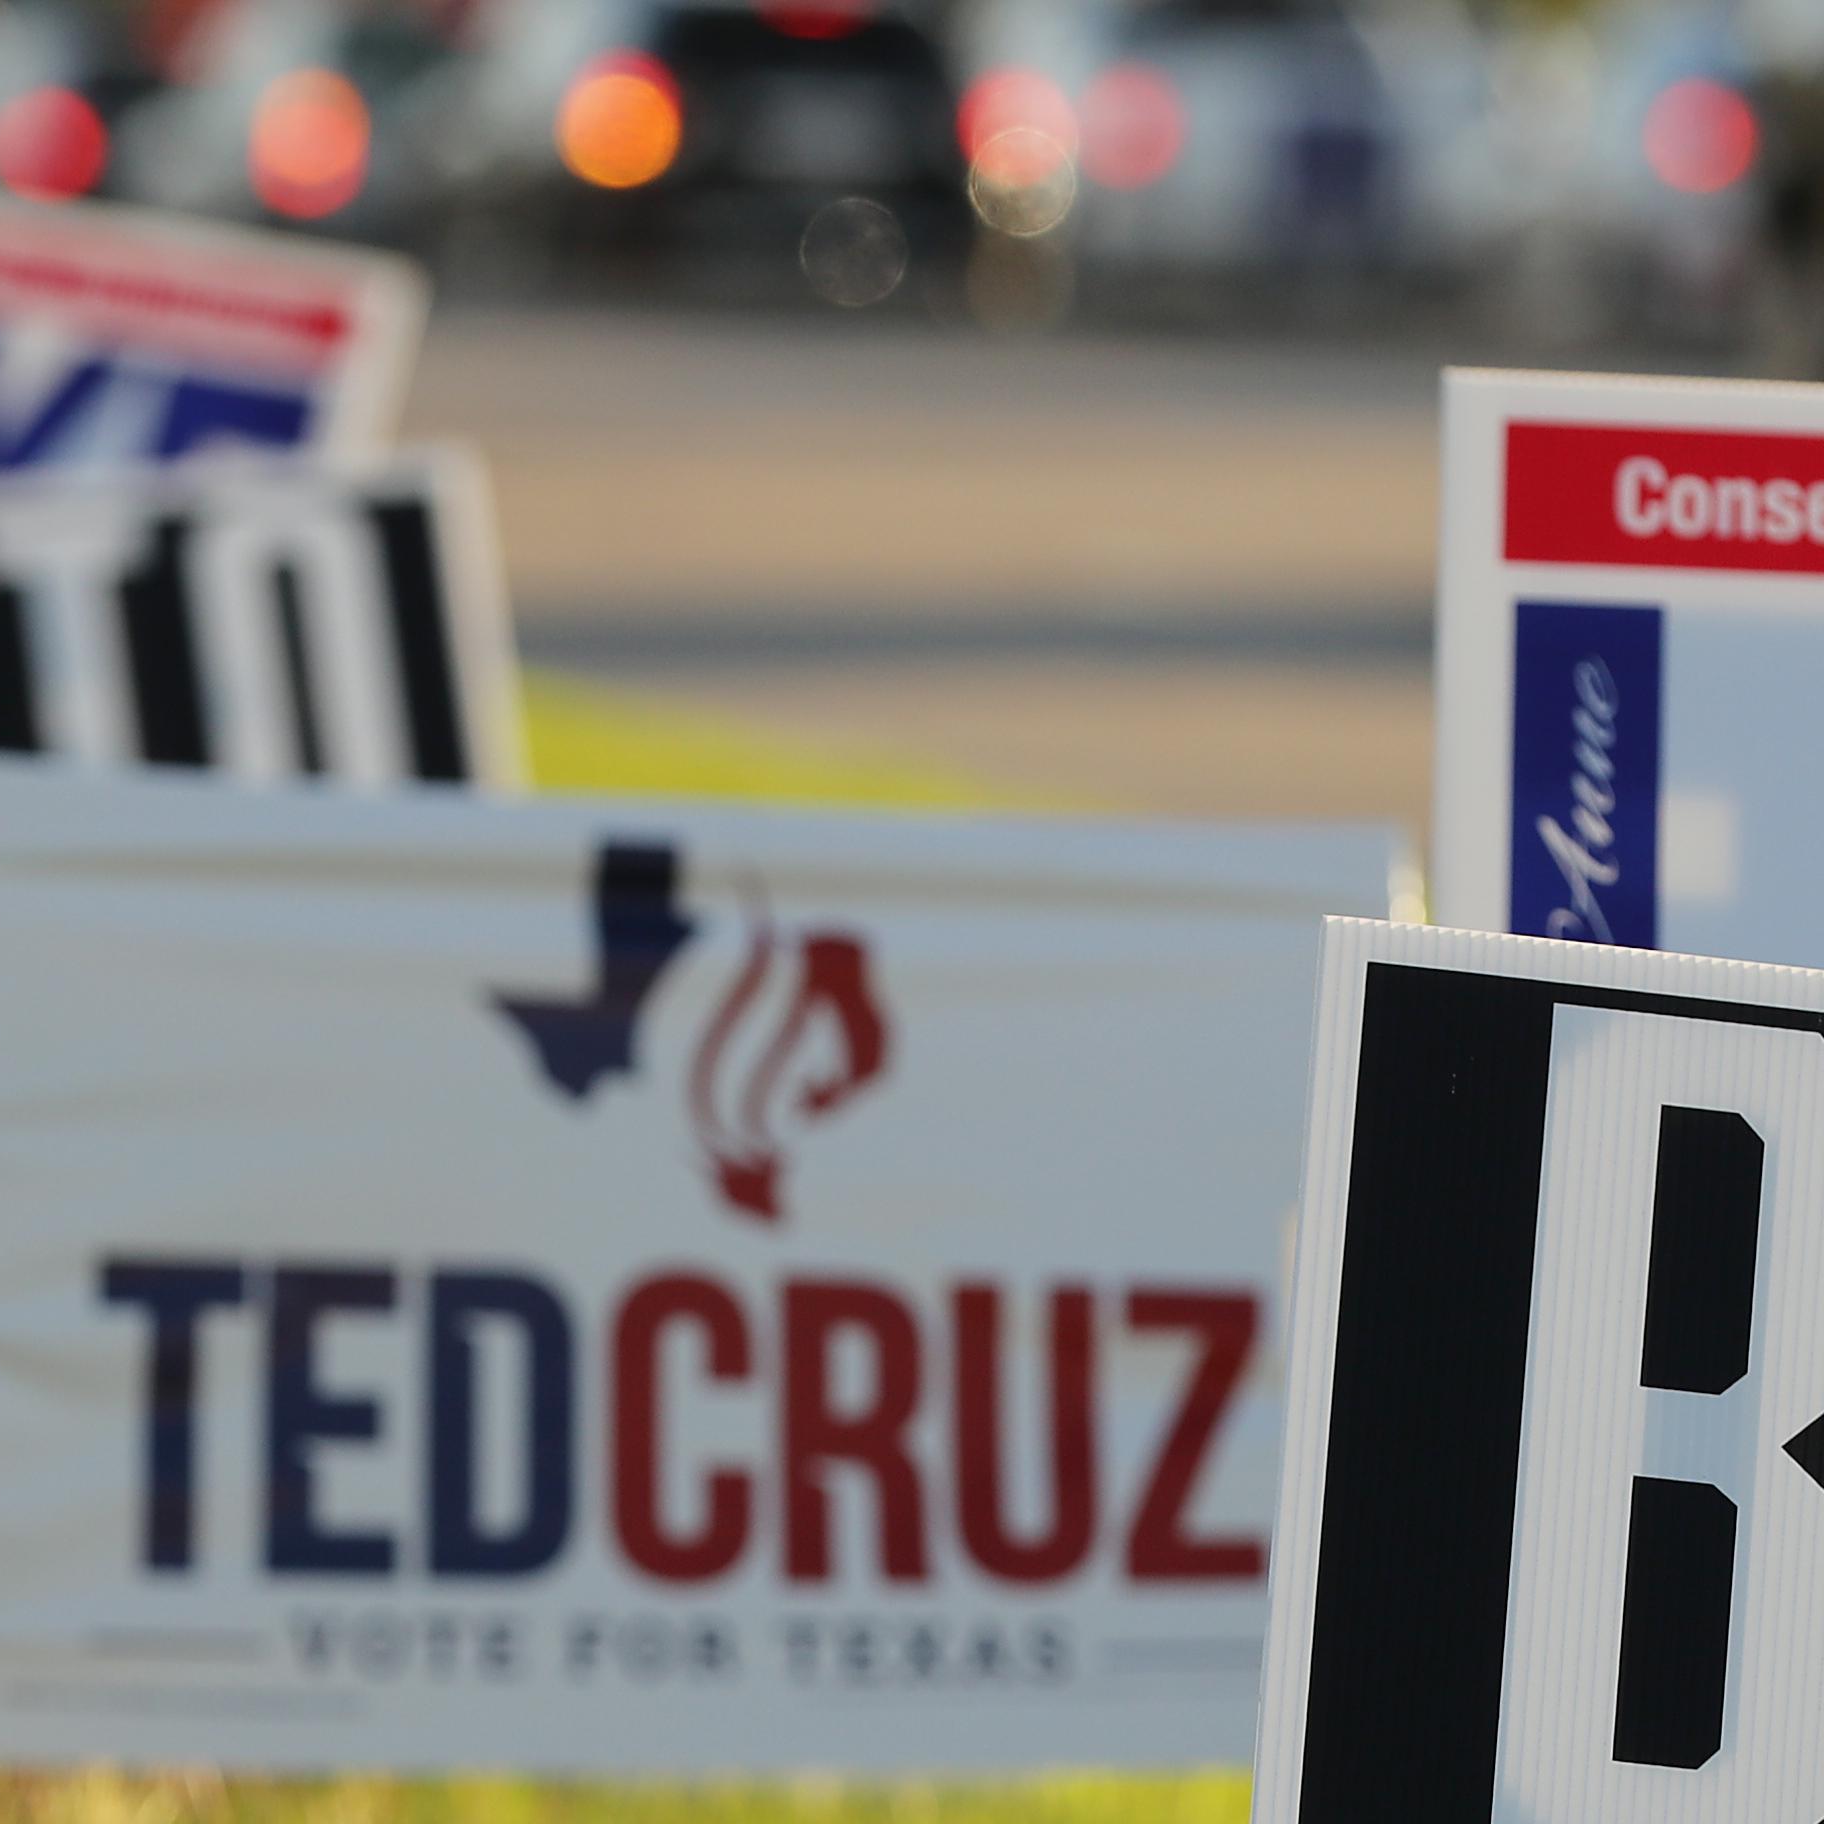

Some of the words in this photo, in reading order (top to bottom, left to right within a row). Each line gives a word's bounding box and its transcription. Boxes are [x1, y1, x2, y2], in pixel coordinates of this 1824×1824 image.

[287, 1607, 522, 1685] VOTE
[566, 1613, 744, 1688] FOR
[784, 1616, 1079, 1690] TEXAS
